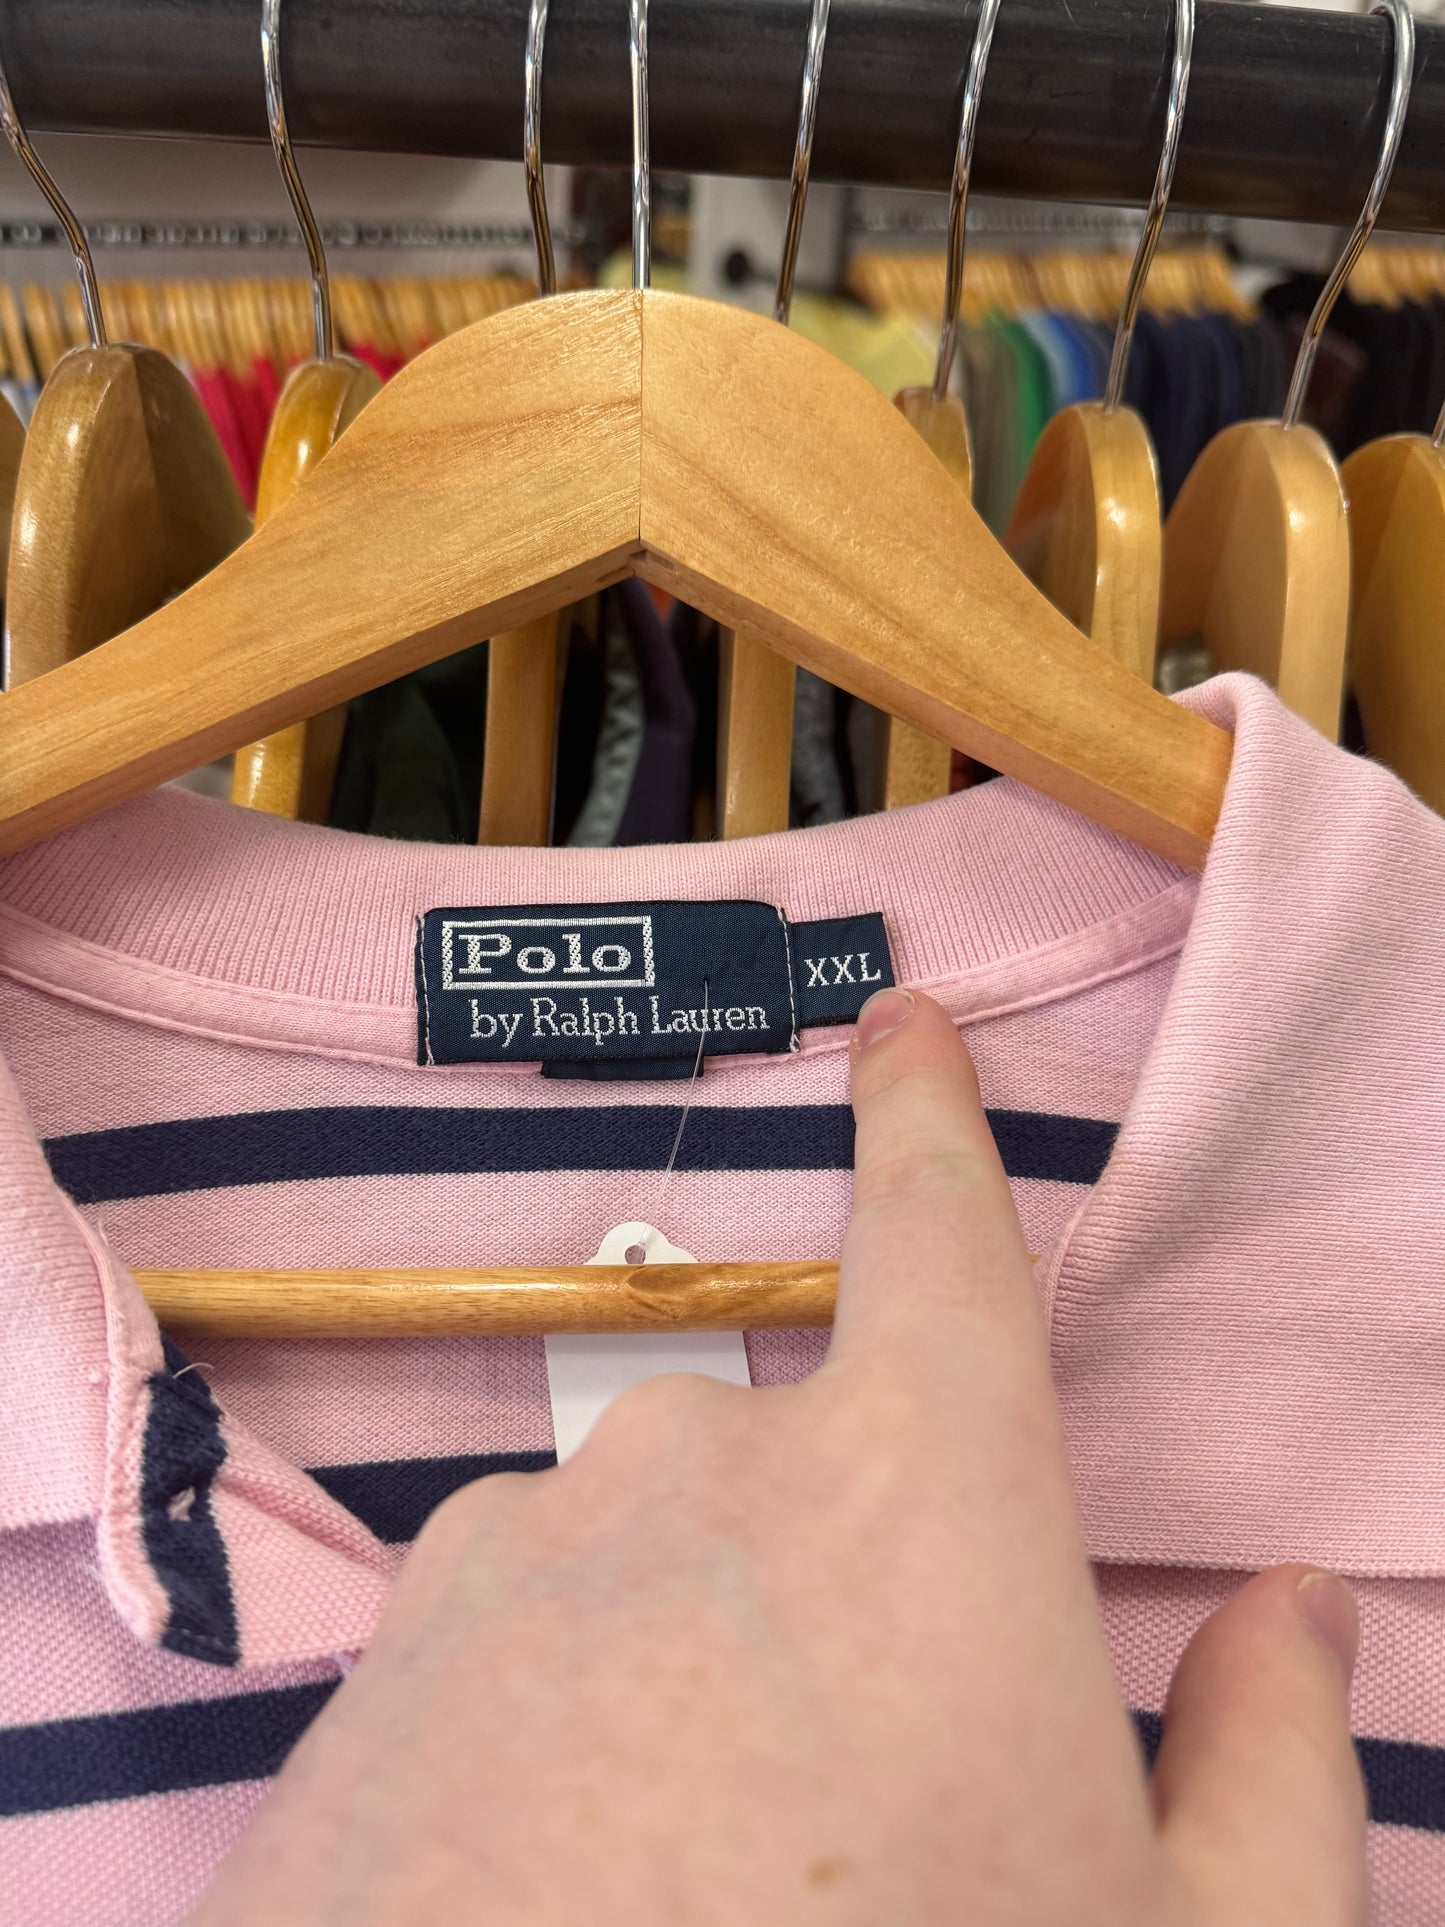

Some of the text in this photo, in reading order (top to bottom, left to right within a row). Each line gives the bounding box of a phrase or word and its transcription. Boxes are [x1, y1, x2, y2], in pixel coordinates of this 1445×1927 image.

[458, 932, 632, 975] Polo
[805, 952, 882, 987] XXL
[468, 995, 770, 1048] by Ralph Lauren
